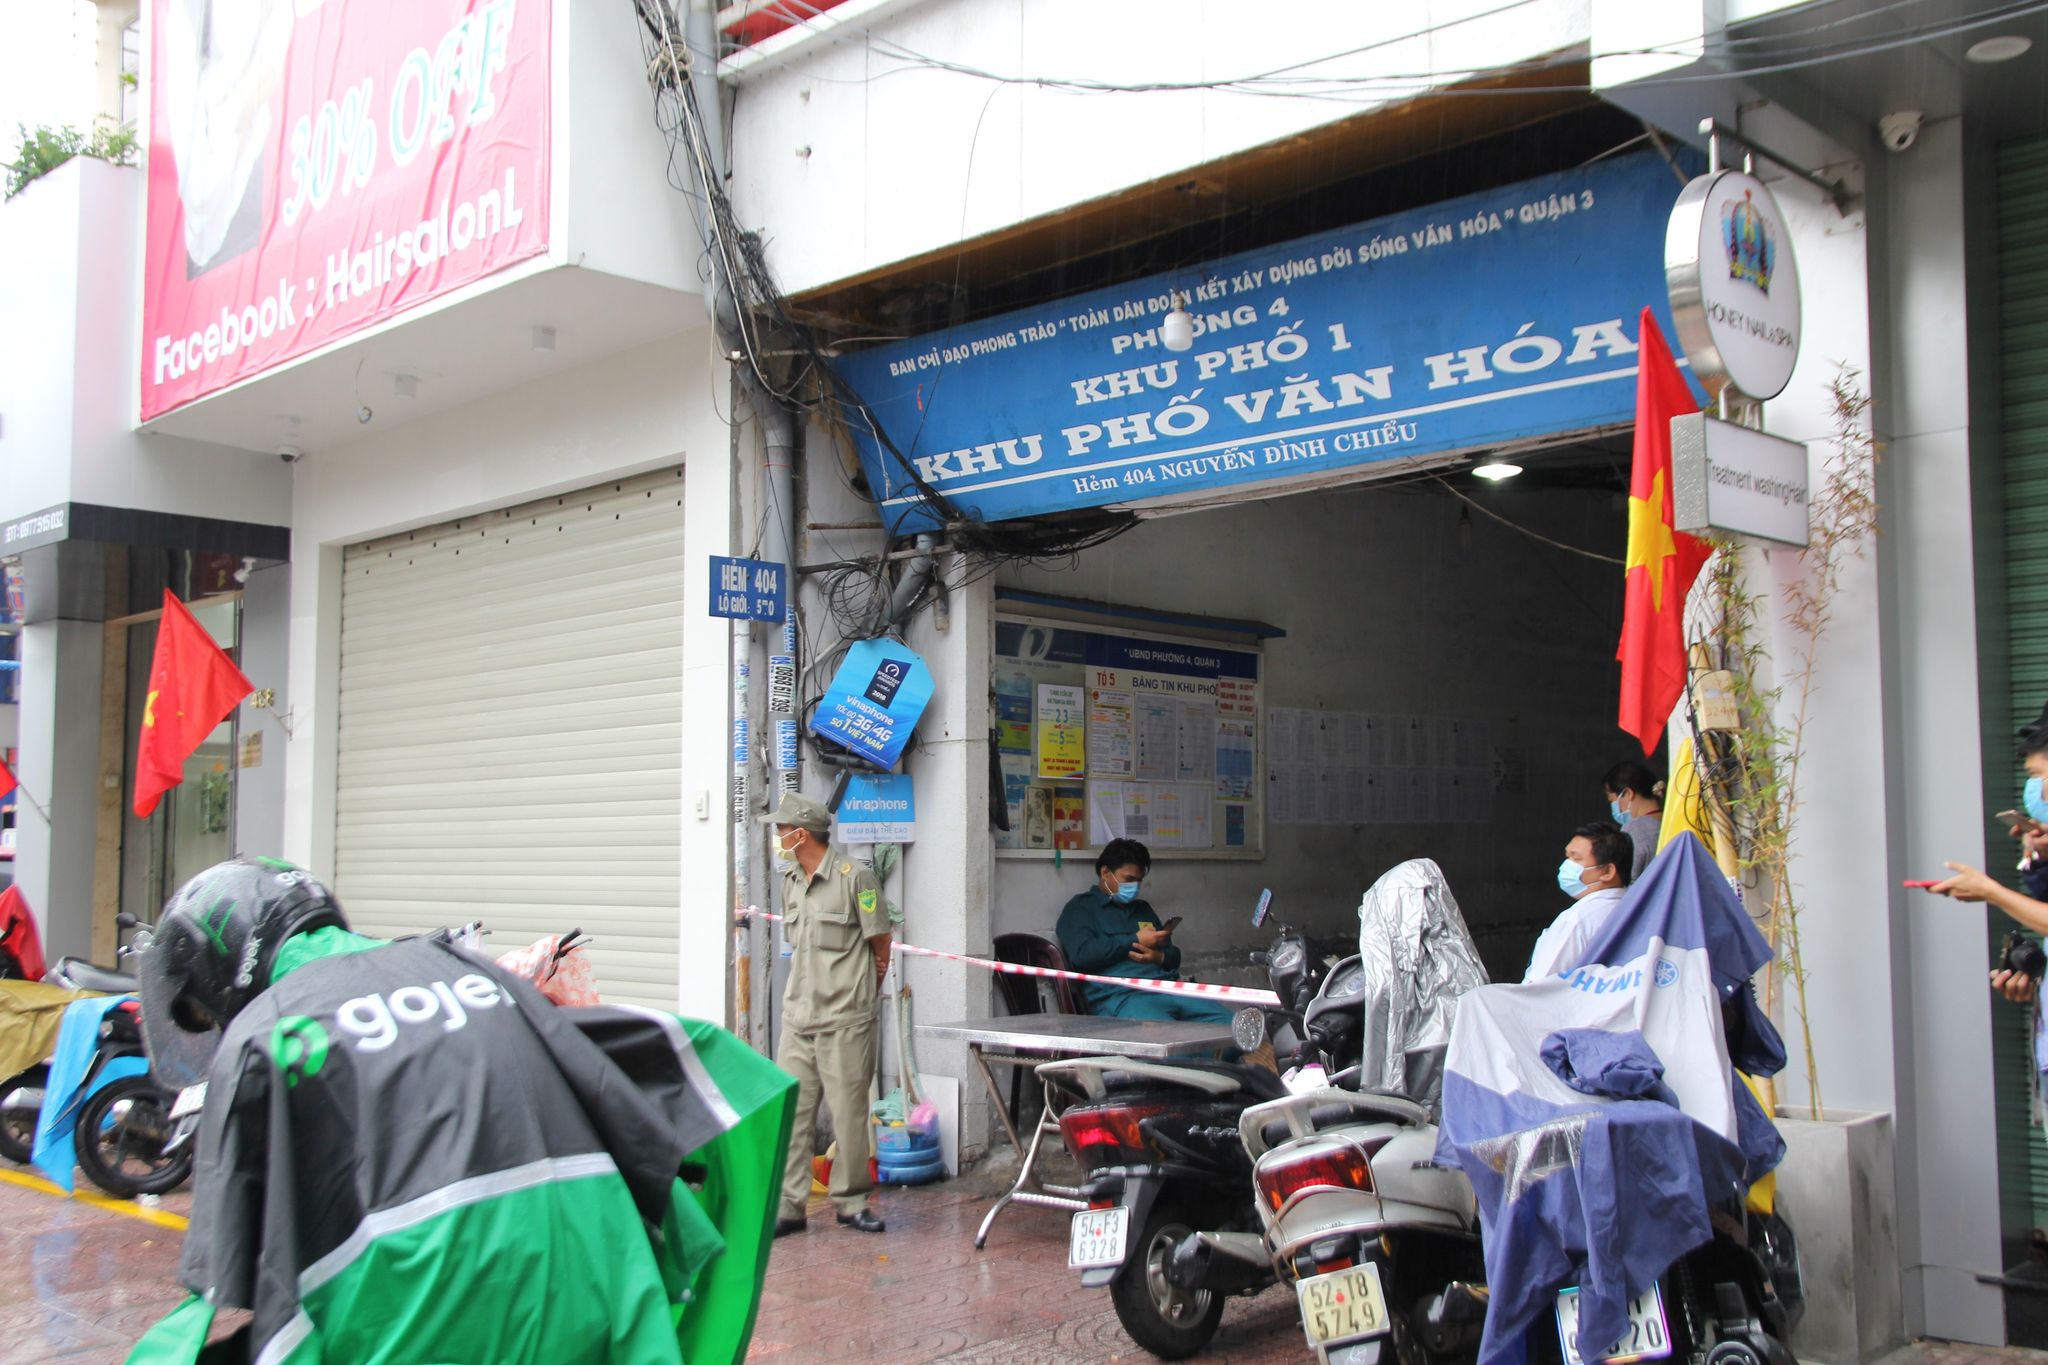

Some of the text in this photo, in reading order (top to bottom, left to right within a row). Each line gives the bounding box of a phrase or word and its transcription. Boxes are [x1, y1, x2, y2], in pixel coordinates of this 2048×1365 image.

[282, 5, 515, 228] 30% OFF
[889, 358, 917, 378] BAN
[917, 346, 941, 371] CHỈ
[942, 343, 970, 367] ĐẠO
[971, 334, 1017, 357] PHONG
[1018, 318, 1057, 345] TRÀO
[1068, 306, 1109, 333] TOÀN
[1113, 300, 1146, 323] DÂN
[1195, 275, 1228, 303] KẾT
[1231, 270, 1263, 294] XÂY
[1269, 258, 1318, 286] DỰNG
[1320, 247, 1353, 273] ĐỜI
[1358, 233, 1408, 263] SỐNG
[1411, 224, 1454, 251] VĂN
[1459, 208, 1502, 239] HÓA
[1519, 191, 1577, 224] QUẬN
[1580, 188, 1595, 210] 3
[1268, 296, 1290, 317] 4
[152, 282, 297, 387] Facebook
[1070, 319, 1352, 406] KHU PHỐ 1
[912, 319, 1640, 484] KHU PHỐ VĂN HÓA
[1072, 419, 1418, 495] Hẻm 404 NGUYỄN ĐÌNH CHIỂU
[721, 558, 777, 595] HẺM 404
[718, 592, 730, 614] LỘ
[1128, 648, 1151, 661] UBND
[1109, 672, 1116, 686] 5
[1132, 675, 1159, 690] BẢNG
[1160, 679, 1175, 691] TIN
[1177, 681, 1196, 694] KHU
[846, 695, 895, 726] vinaphone
[851, 714, 894, 742] 3G/4G
[863, 736, 885, 751] NAM
[844, 796, 909, 813] vinaphone
[233, 935, 264, 989] gojek
[336, 970, 517, 1051] goje
[1078, 1237, 1118, 1262] 6328
[1315, 1301, 1376, 1340] 5749
